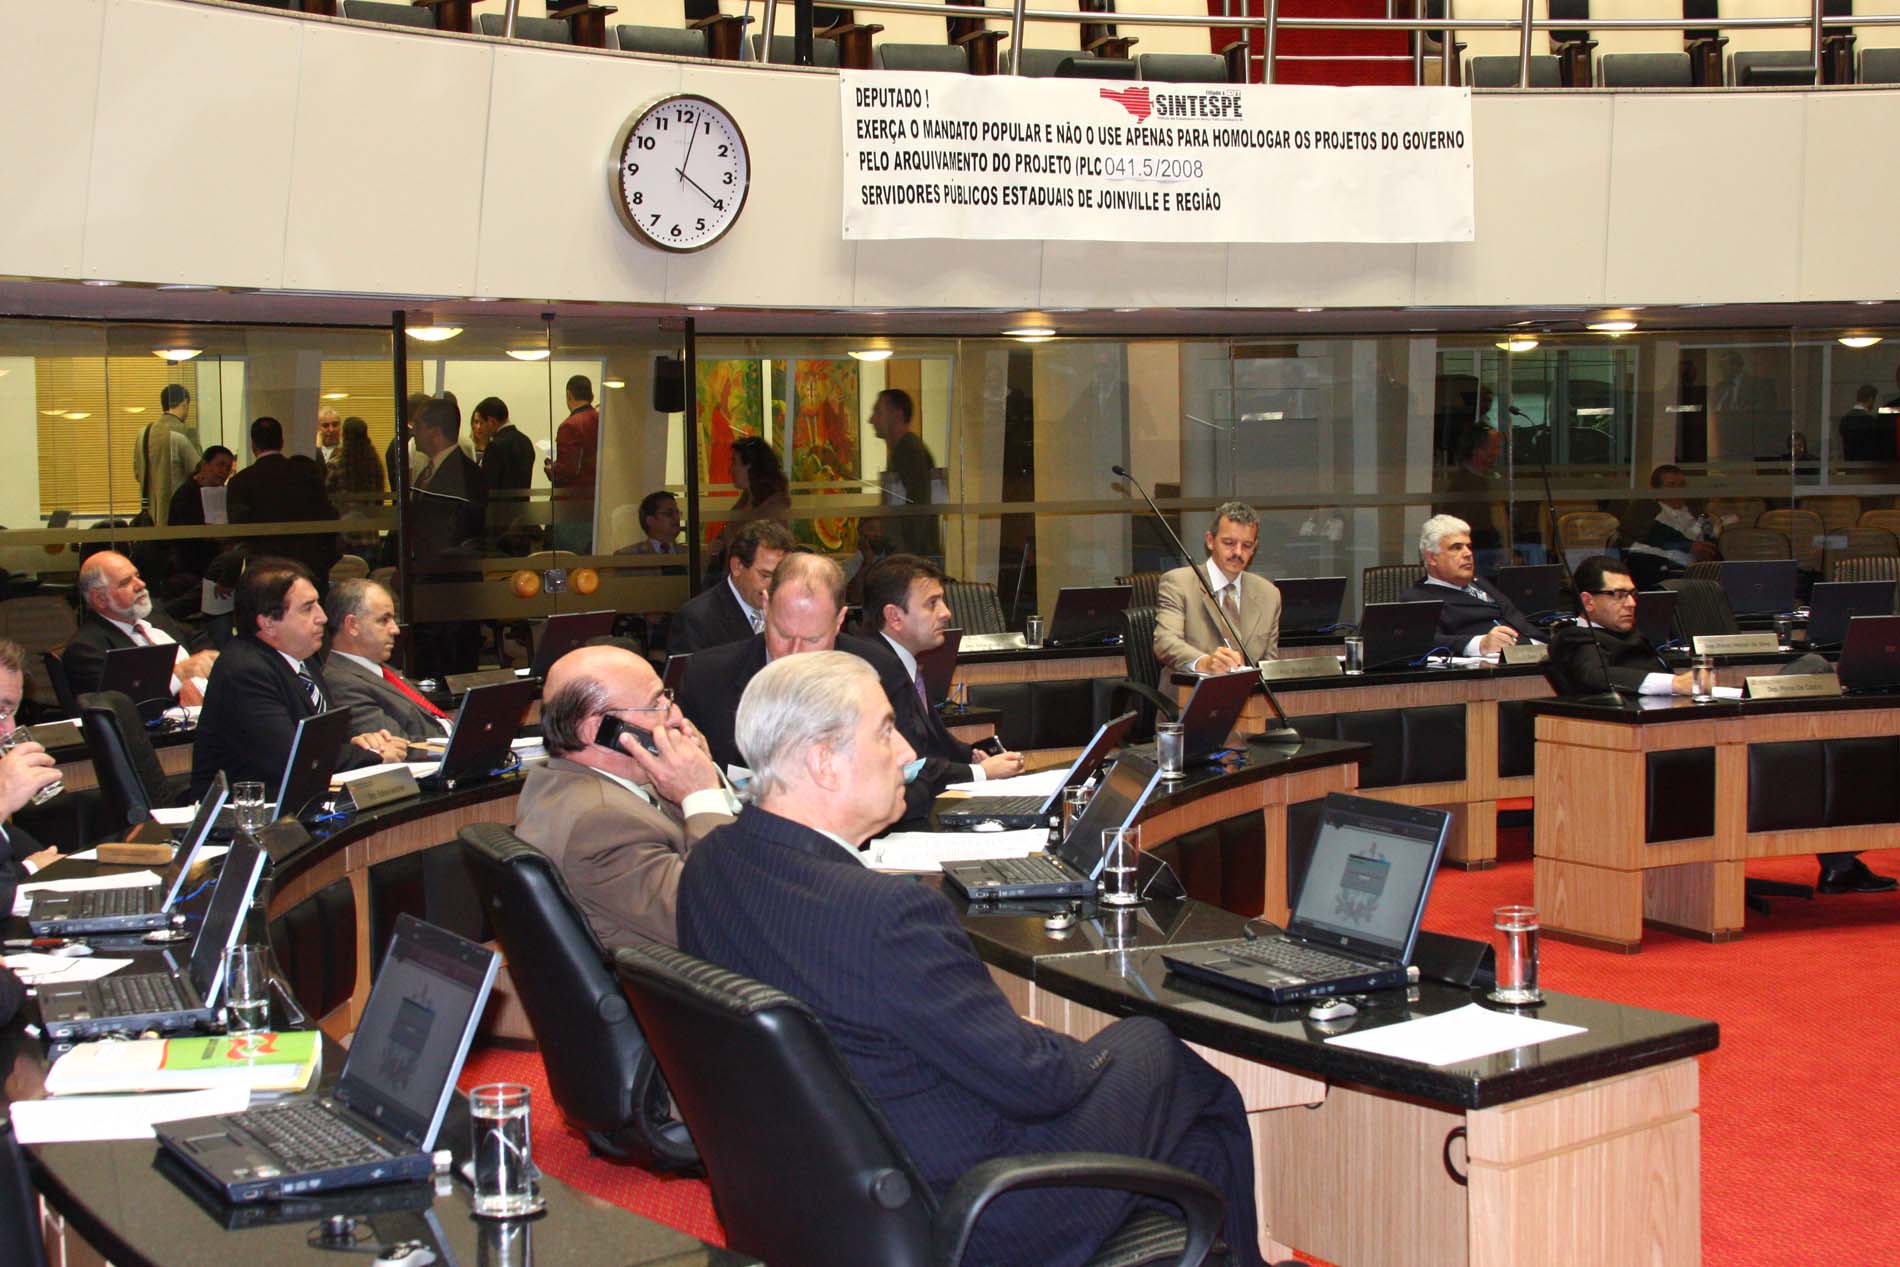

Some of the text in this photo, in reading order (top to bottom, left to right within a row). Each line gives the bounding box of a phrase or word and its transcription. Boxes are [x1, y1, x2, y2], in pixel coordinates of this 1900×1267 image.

[856, 87, 921, 108] DEPUTADO
[1156, 94, 1242, 117] SINTESPE
[676, 109, 694, 123] 12
[656, 117, 668, 130] 11
[704, 122, 710, 134] 1
[857, 119, 906, 144] EXERÇA
[911, 119, 918, 139] O
[924, 119, 977, 141] MANDATO
[983, 121, 1041, 143] POPULAR
[1046, 124, 1052, 143] E
[1086, 125, 1094, 145] O
[1098, 126, 1121, 145] USE
[1126, 127, 1173, 147] APENAS
[1178, 128, 1209, 147] PARA
[1213, 128, 1290, 149] HOMOLOGAR
[1295, 130, 1311, 149] OS
[1315, 131, 1377, 150] PROJETOS
[1382, 131, 1398, 150] DO
[1403, 131, 1464, 150] GOVERNO
[637, 136, 655, 150] 10
[718, 145, 728, 157] 2
[859, 151, 889, 171] PELO
[894, 150, 987, 172] ARQUIVAMENTO
[993, 152, 1010, 173] DO
[1015, 153, 1071, 174] PROJETO
[628, 163, 639, 176] 9
[723, 172, 732, 184] 3
[633, 192, 642, 205] 8
[862, 184, 940, 206] SERVIDORES
[1002, 185, 1073, 208] ESTADUAIS
[1078, 188, 1093, 209] DE
[1096, 190, 1160, 211] JOINVILLE
[1163, 192, 1170, 211] E
[713, 199, 723, 211] 4
[651, 214, 661, 226] 7
[696, 218, 705, 230] 5
[671, 225, 681, 236] 6
